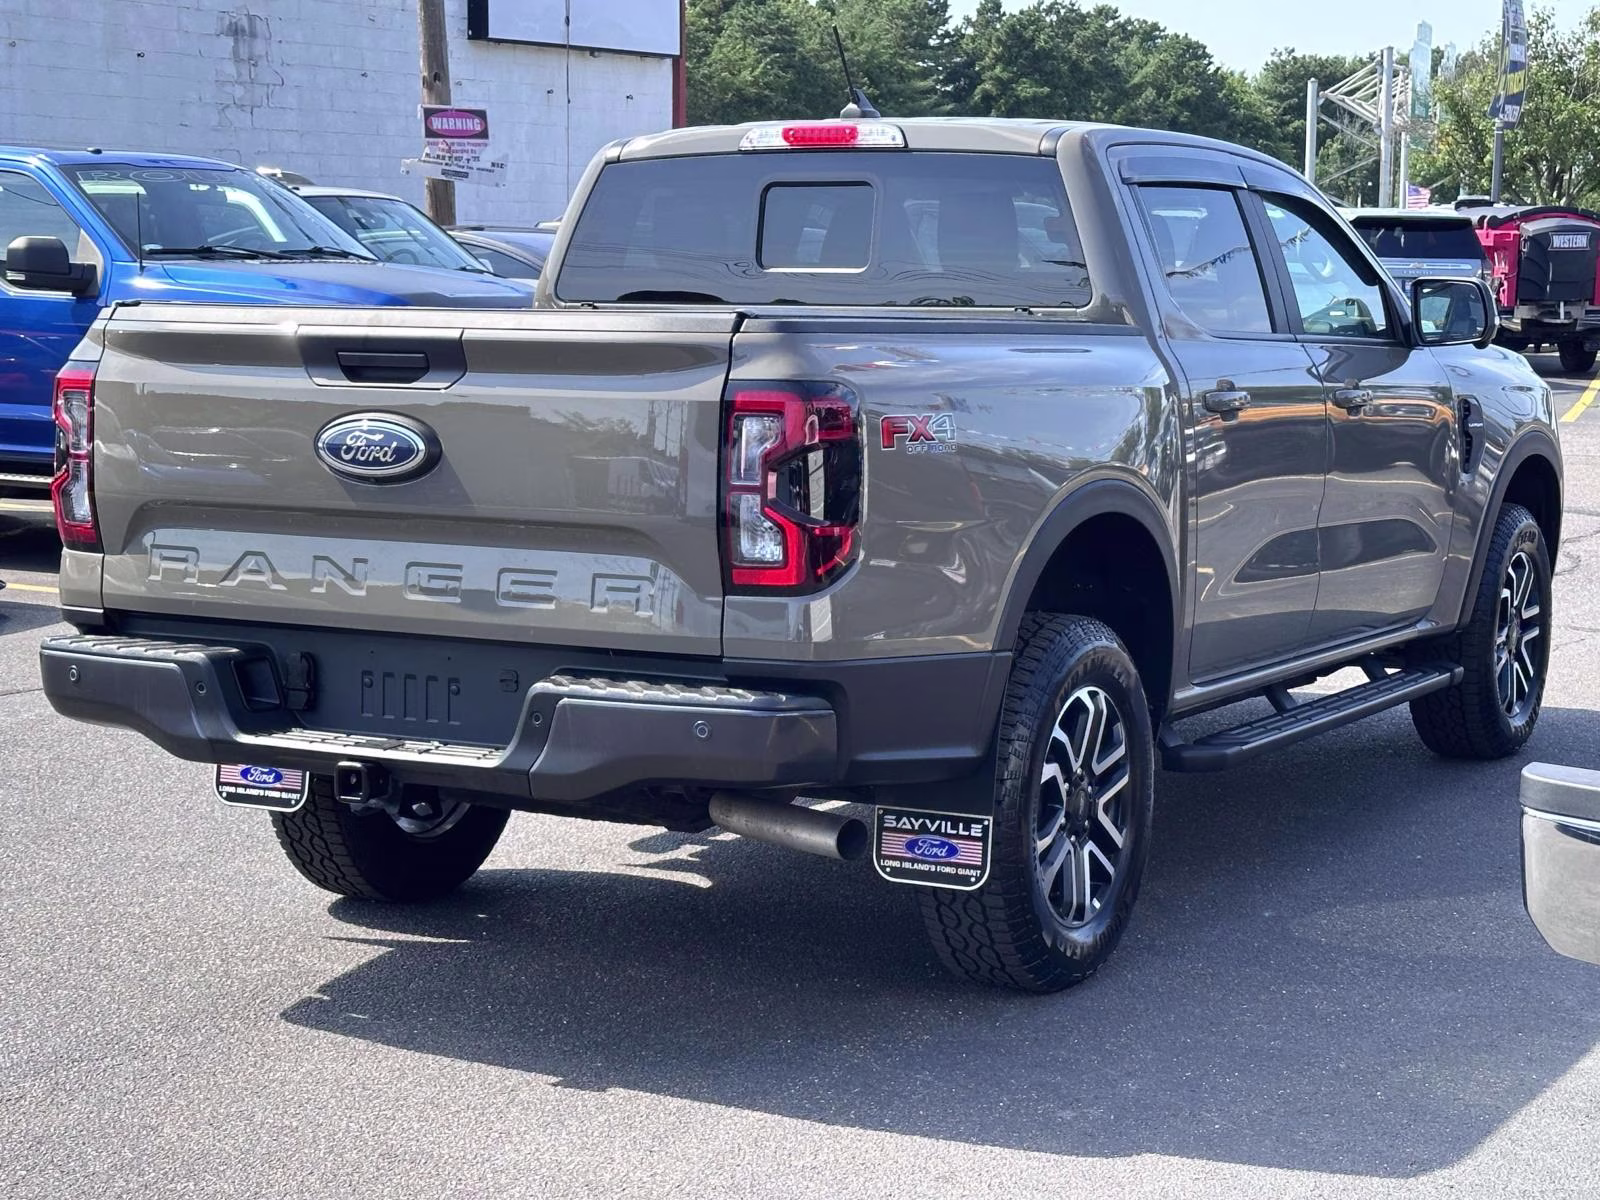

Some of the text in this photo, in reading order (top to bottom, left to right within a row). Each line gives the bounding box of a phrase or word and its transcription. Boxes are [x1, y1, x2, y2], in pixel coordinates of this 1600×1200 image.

[431, 117, 481, 130] WARNING
[1552, 235, 1588, 248] WESTERN
[880, 413, 957, 451] FX4
[340, 430, 398, 463] Ford
[906, 442, 958, 454] OFF ROAD
[147, 543, 657, 619] RANGER
[247, 766, 276, 783] Ford
[219, 785, 236, 793] LONG
[883, 815, 984, 837] SAYVILLE
[914, 838, 949, 857] Ford
[880, 859, 982, 878] LONG ISLAND'S FORD GIANT
